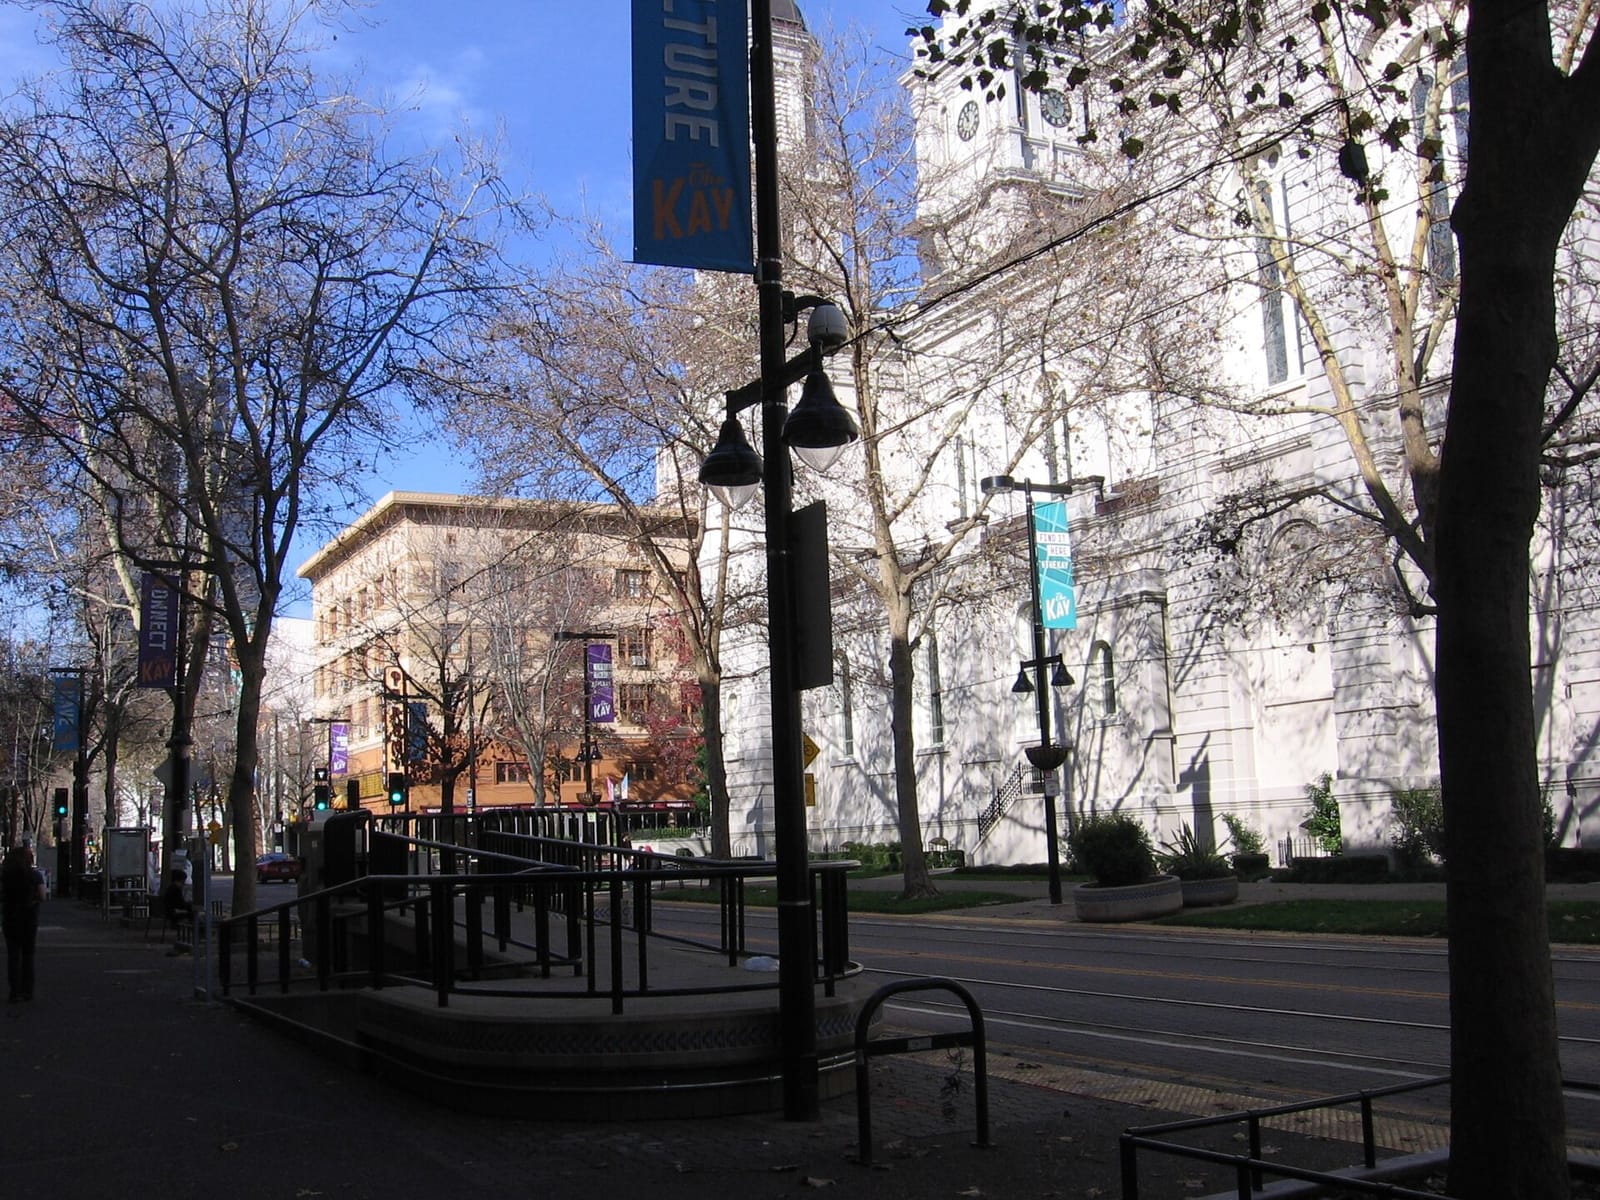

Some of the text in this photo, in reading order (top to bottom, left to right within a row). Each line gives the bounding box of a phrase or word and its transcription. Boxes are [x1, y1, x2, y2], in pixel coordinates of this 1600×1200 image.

[653, 179, 734, 241] KAY
[1039, 533, 1056, 542] FIND
[1046, 598, 1070, 621] KAY
[593, 704, 611, 718] KAY
